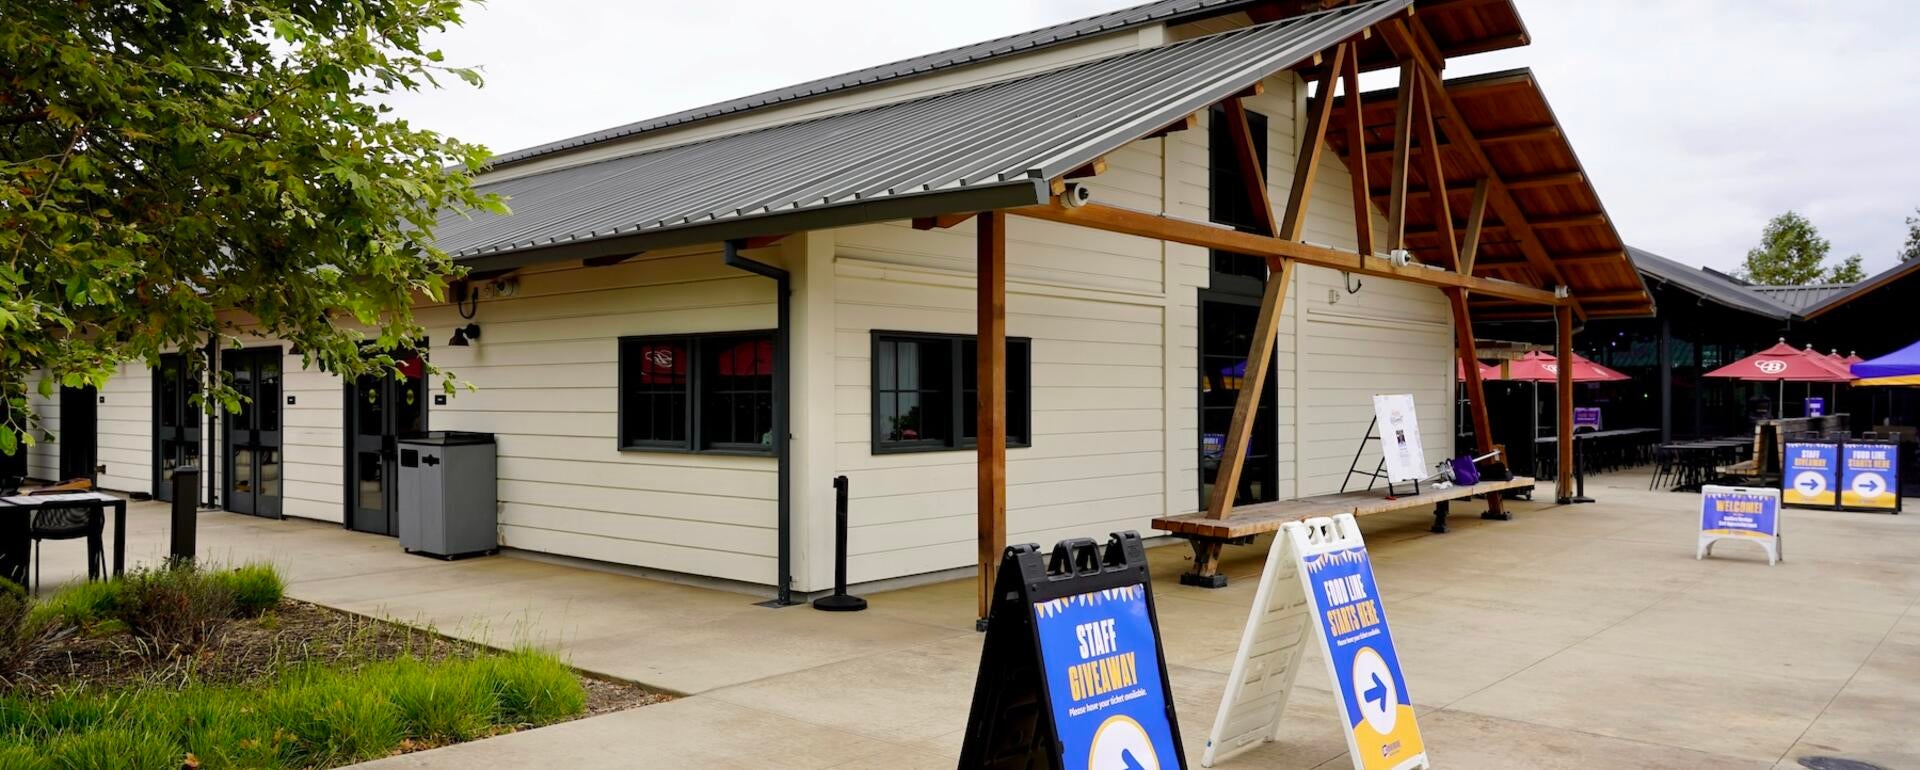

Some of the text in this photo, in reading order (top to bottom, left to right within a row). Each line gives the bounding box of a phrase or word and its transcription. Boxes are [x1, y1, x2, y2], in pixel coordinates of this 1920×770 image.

[1801, 450, 1820, 458] STAFF
[1852, 450, 1886, 460] FOOD LINE
[1716, 500, 1763, 514] WELCOME!
[1323, 573, 1367, 607] FOOD LINE
[1327, 599, 1380, 637] STARTS HERE
[1075, 618, 1117, 659] STAFF
[1068, 651, 1138, 701] GIVEAWAY
[1069, 688, 1147, 718] Please have your ticket available.
